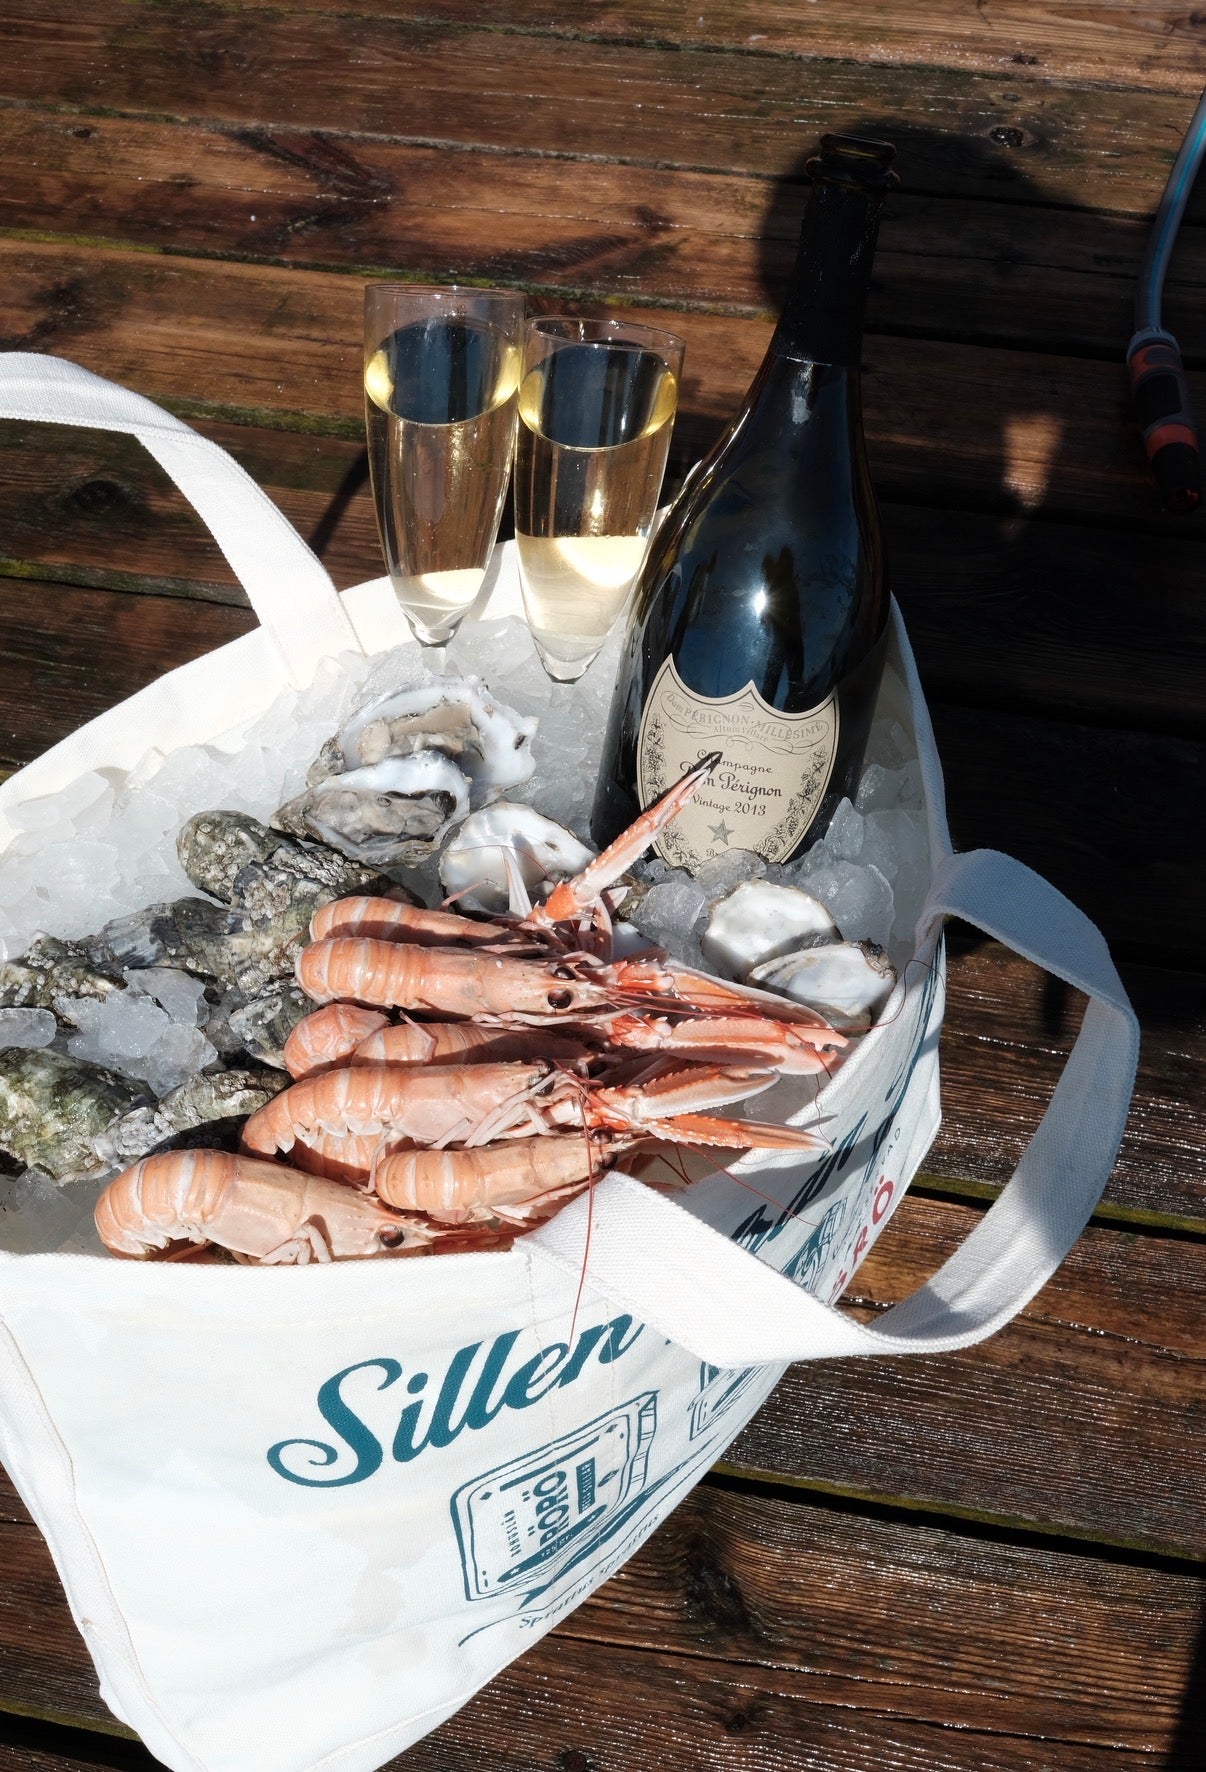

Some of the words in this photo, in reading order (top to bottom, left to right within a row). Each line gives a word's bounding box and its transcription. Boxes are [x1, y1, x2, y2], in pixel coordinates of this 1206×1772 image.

[692, 794, 731, 813] Vintage
[734, 801, 766, 816] 2013
[719, 772, 782, 800] Pérignon
[267, 1314, 644, 1488] Sillen
[522, 1470, 570, 1546] RÖRÖ
